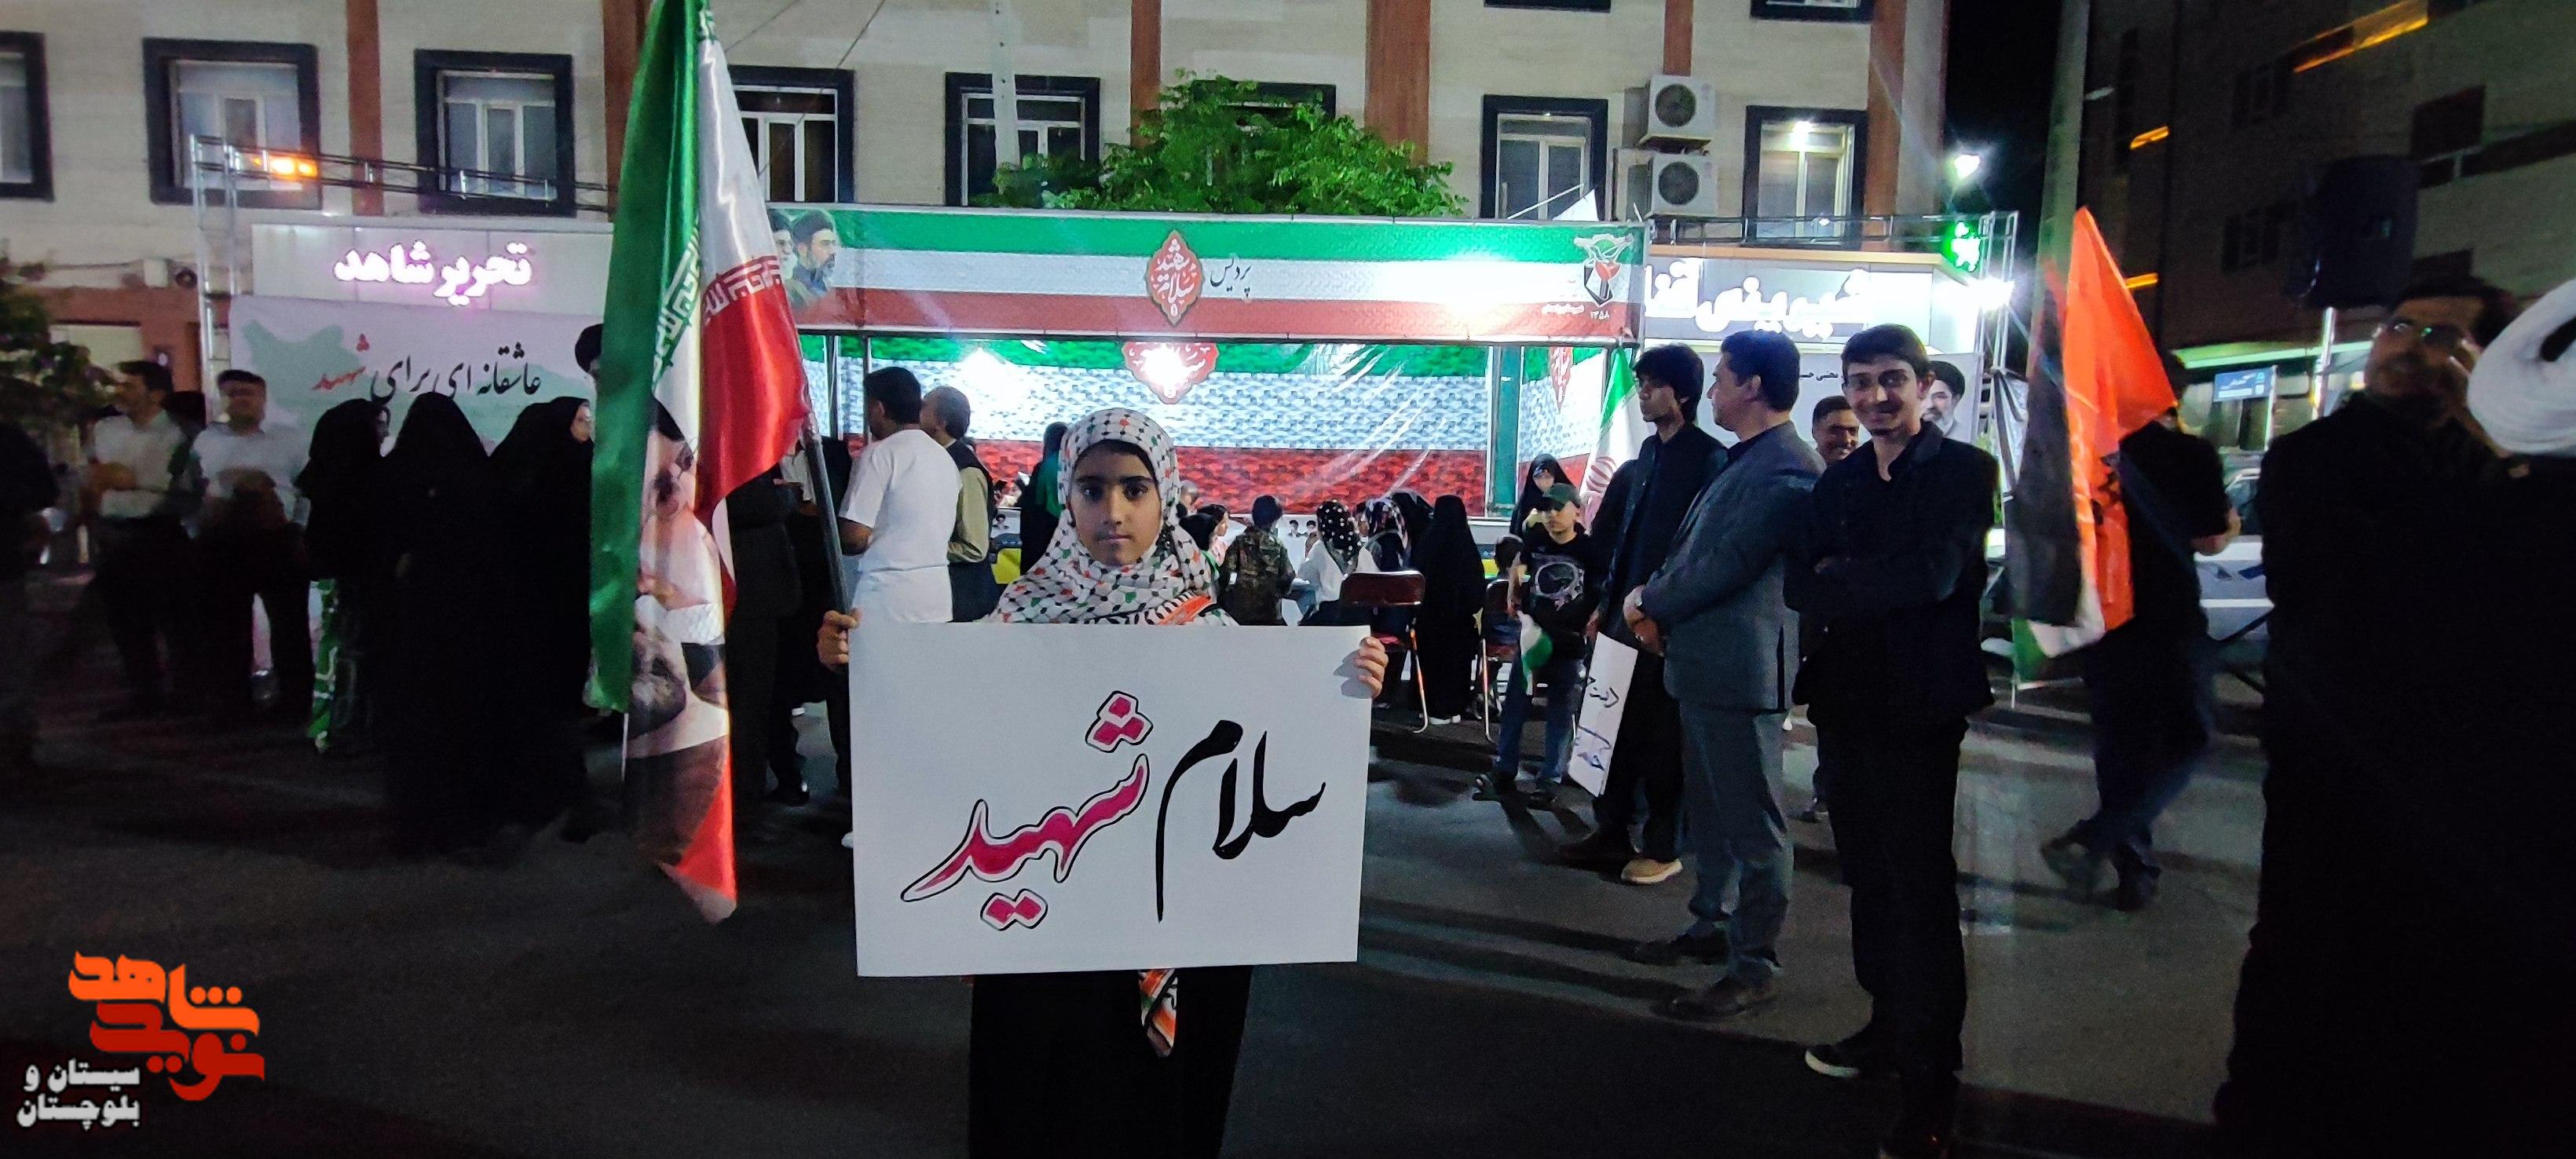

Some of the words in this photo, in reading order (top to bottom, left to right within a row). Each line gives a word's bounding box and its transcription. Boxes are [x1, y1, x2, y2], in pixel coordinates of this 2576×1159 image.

[333, 239, 435, 283] شاهد
[434, 242, 533, 306] تحریر
[1210, 258, 1252, 298] پردیس
[1644, 258, 1703, 319] قنا
[311, 333, 368, 391] شهید
[370, 355, 431, 404] برای
[477, 341, 542, 396] عاشقانه
[900, 689, 1154, 931] شهید
[1155, 718, 1326, 923] سلام
